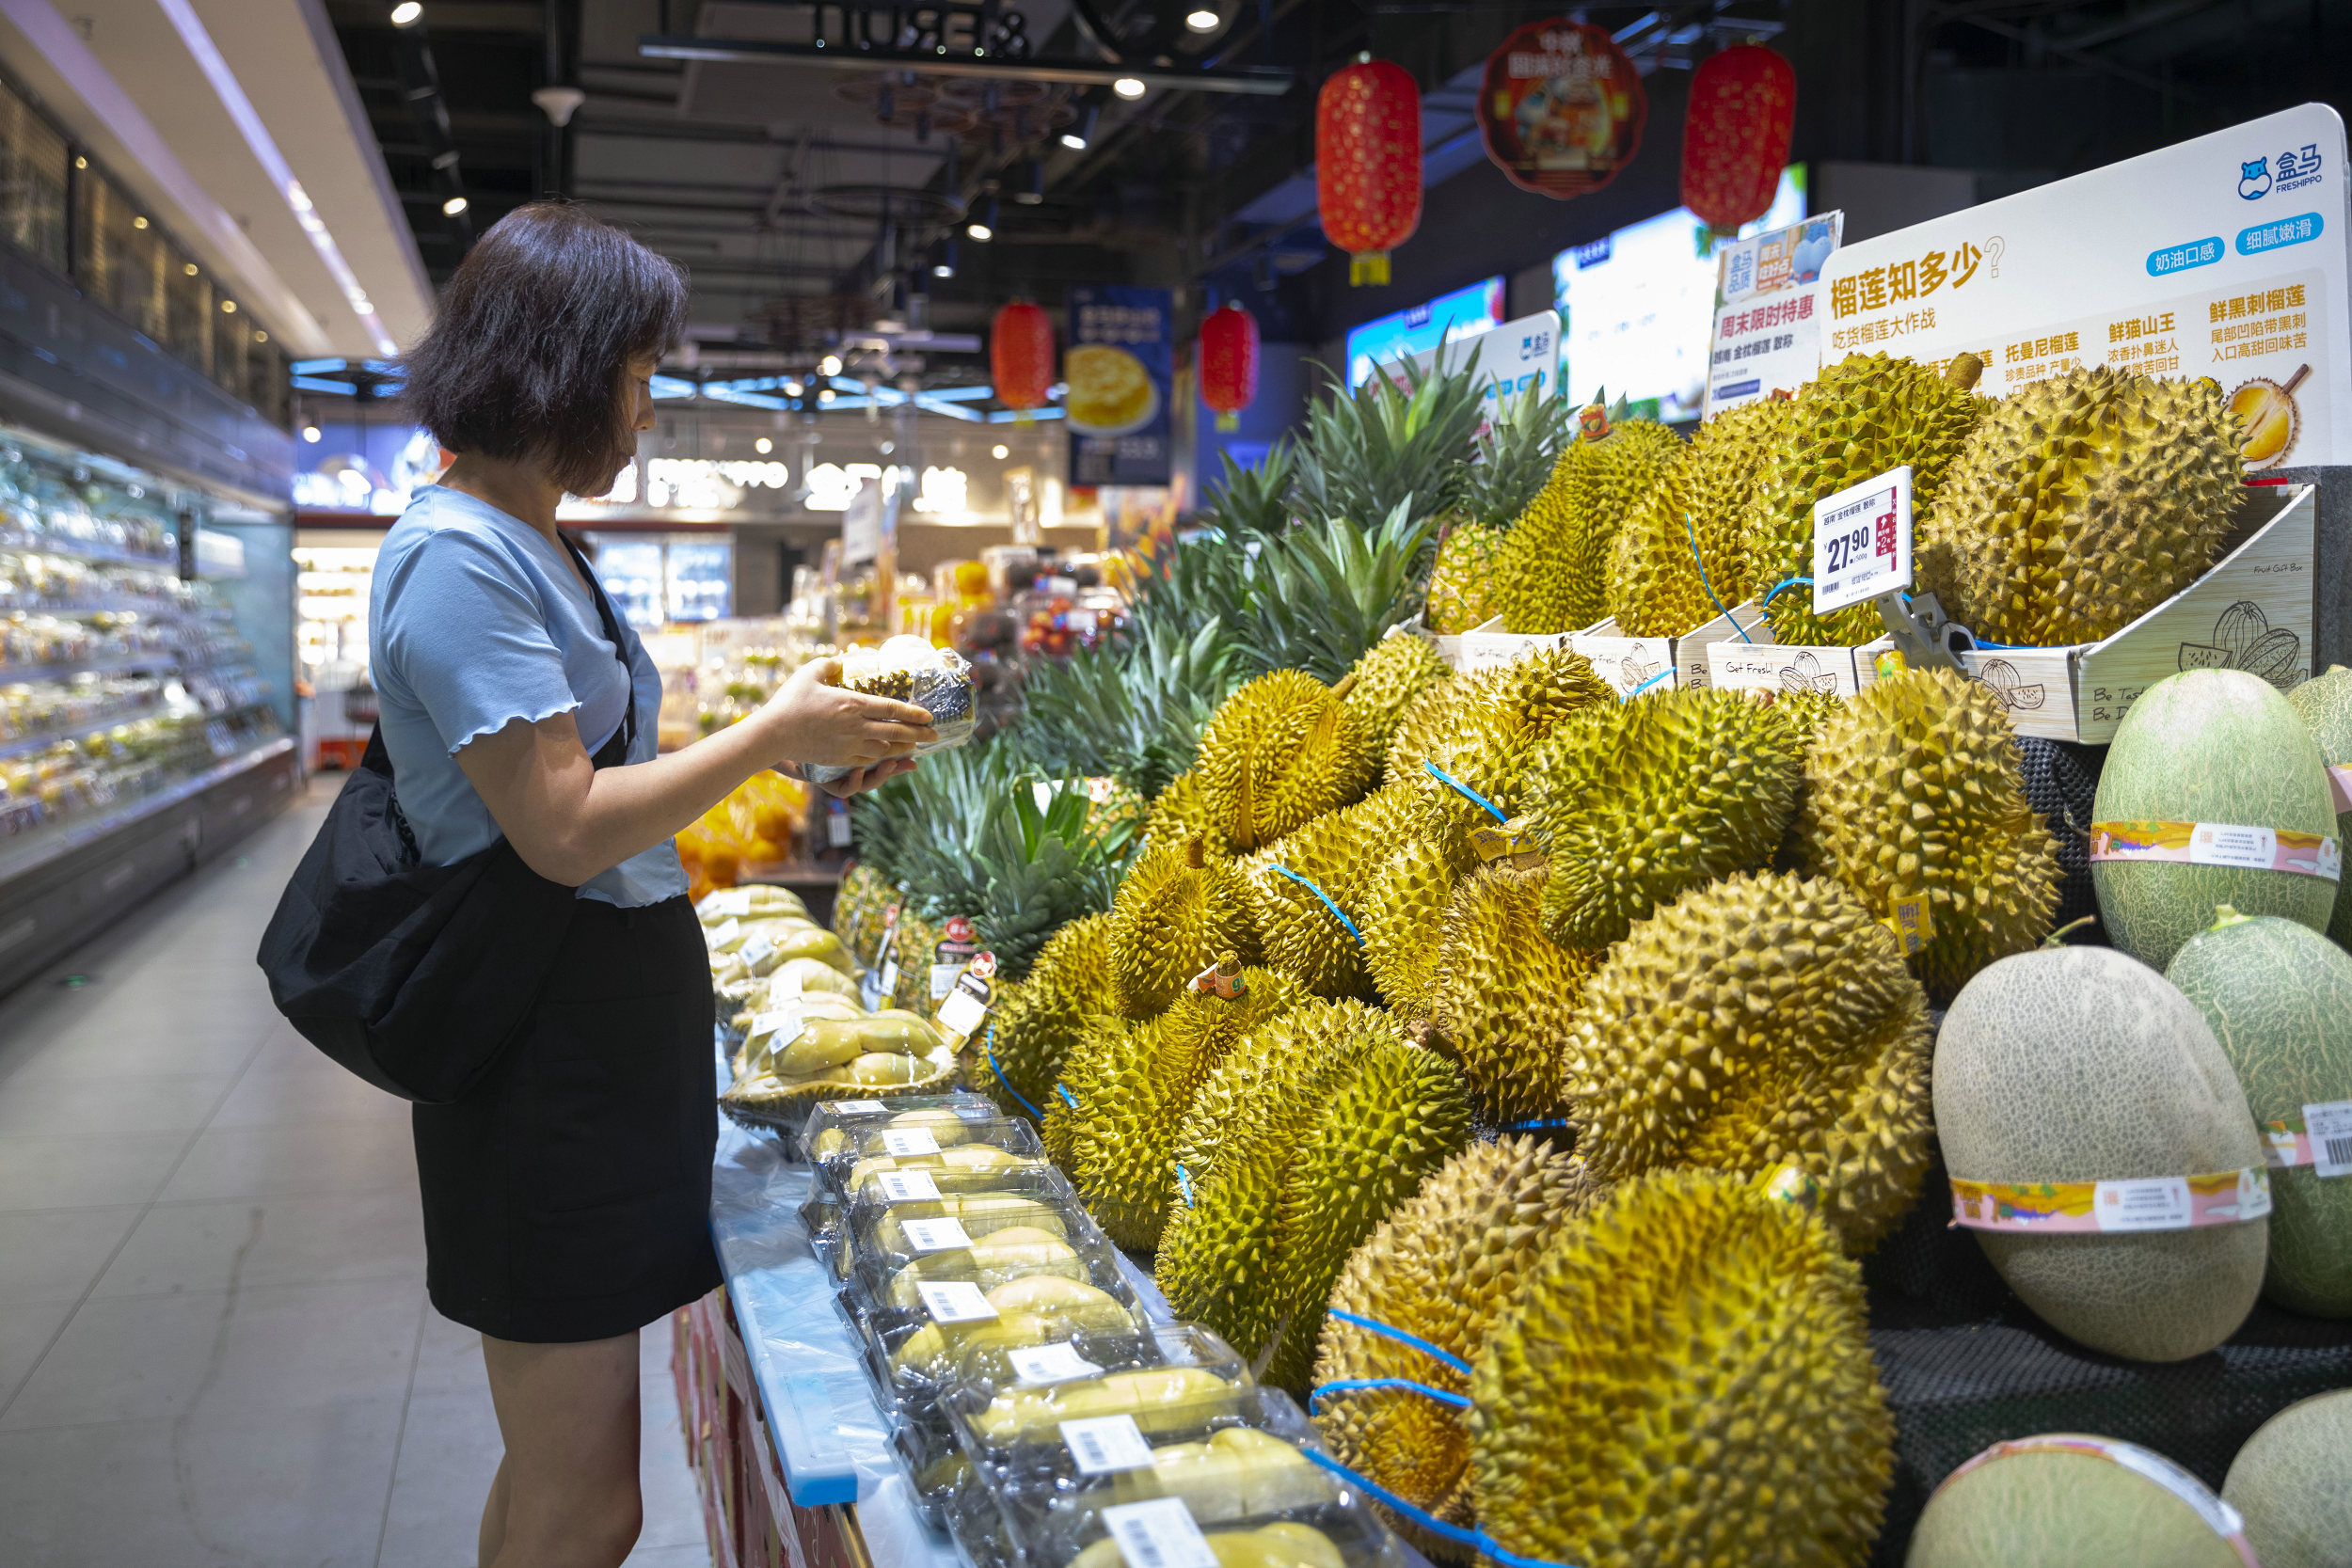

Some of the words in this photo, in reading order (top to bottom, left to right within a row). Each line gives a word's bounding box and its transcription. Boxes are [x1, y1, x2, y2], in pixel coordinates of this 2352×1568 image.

[2275, 144, 2322, 182] 盒马
[2276, 175, 2323, 194] FRESHIPPO
[2246, 218, 2312, 250] 细腻嫩滑
[2155, 242, 2216, 272] 奶油口感
[1720, 294, 1815, 340] 周末限时特惠
[2209, 284, 2306, 324] 鲜黑刺榴莲
[1833, 307, 1936, 350] 吃货榴莲大作战
[2108, 312, 2176, 343] 鲜猫山王
[2211, 312, 2306, 344] 尾部凹陷带黑刺
[2006, 331, 2079, 364] 托曼尼榴莲
[2108, 337, 2179, 364] 浓香扑鼻迷人
[2211, 332, 2307, 363] 入口高甜回味苦
[2005, 363, 2046, 382] 珍贵品种
[2273, 563, 2288, 573] Gift
[2290, 563, 2303, 572] Box
[1691, 663, 1708, 674] Be
[1725, 661, 1743, 673] Get
[1746, 662, 1773, 674] Fresh!
[2093, 688, 2112, 702] Be
[2092, 706, 2111, 721] Be
